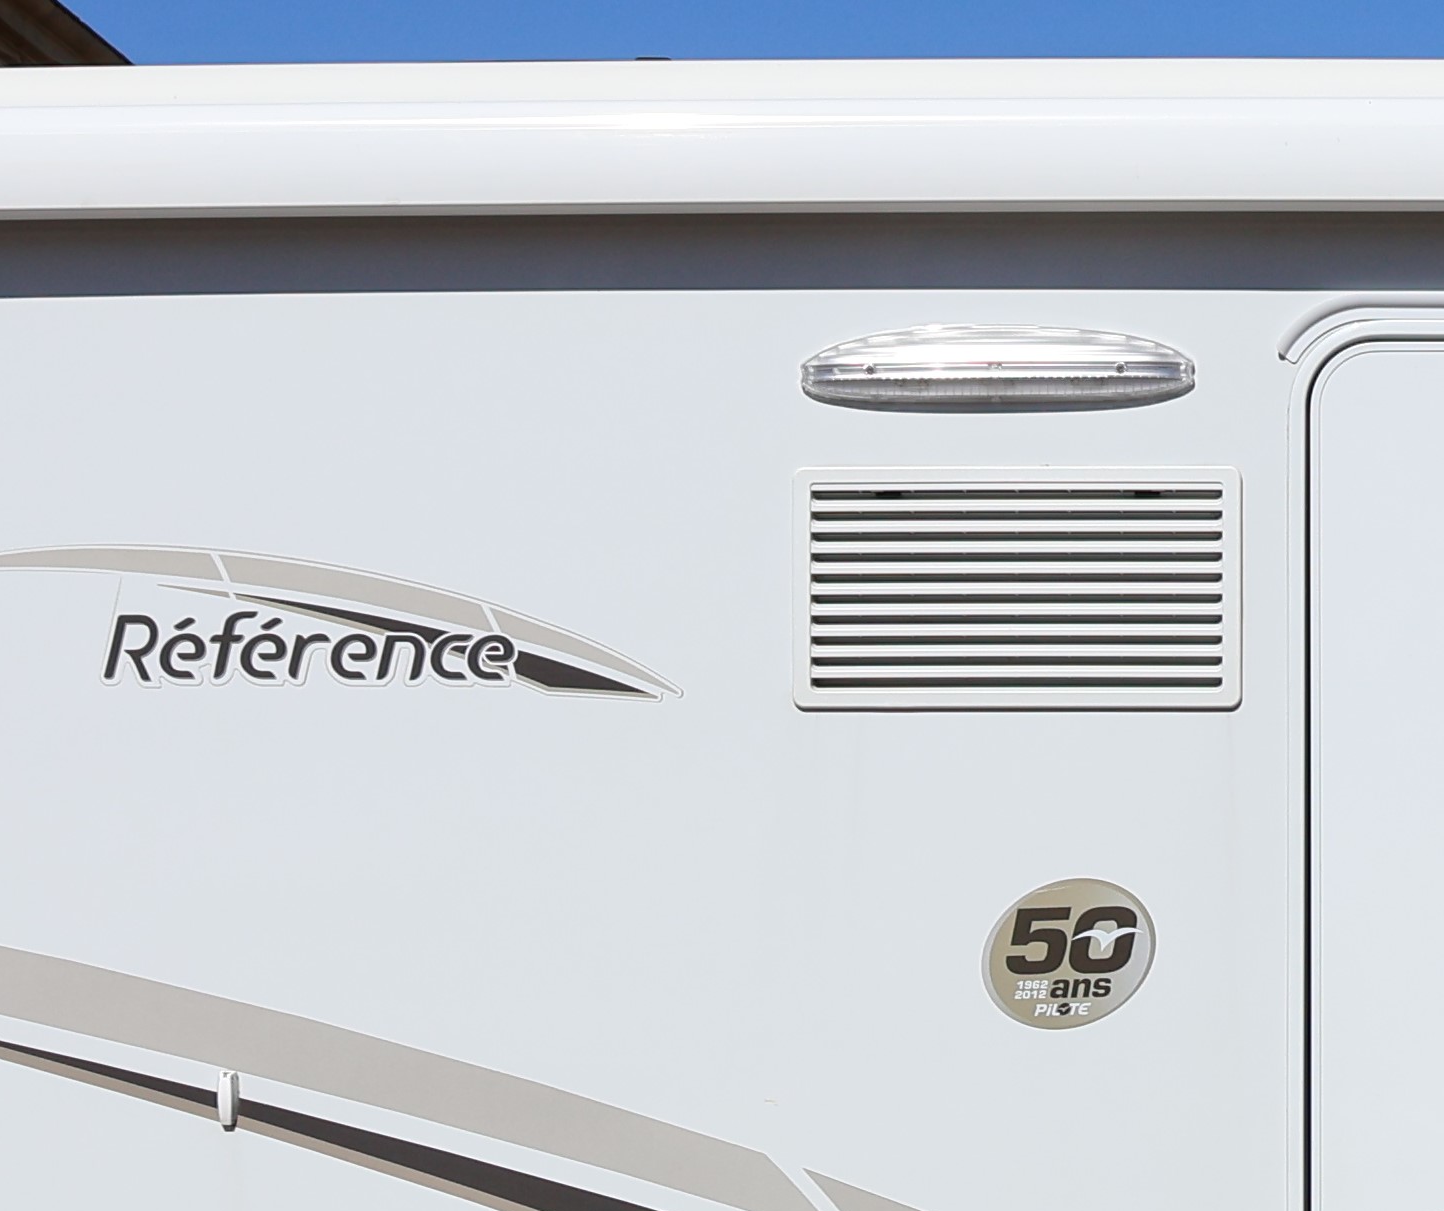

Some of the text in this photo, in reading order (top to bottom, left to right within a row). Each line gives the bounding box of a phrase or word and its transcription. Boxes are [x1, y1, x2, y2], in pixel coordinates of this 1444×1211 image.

[102, 610, 517, 682] Référence
[1006, 906, 1138, 974] 50
[1014, 990, 1048, 1000] 2012
[1016, 980, 1049, 990] 1962
[1049, 977, 1112, 999] ans
